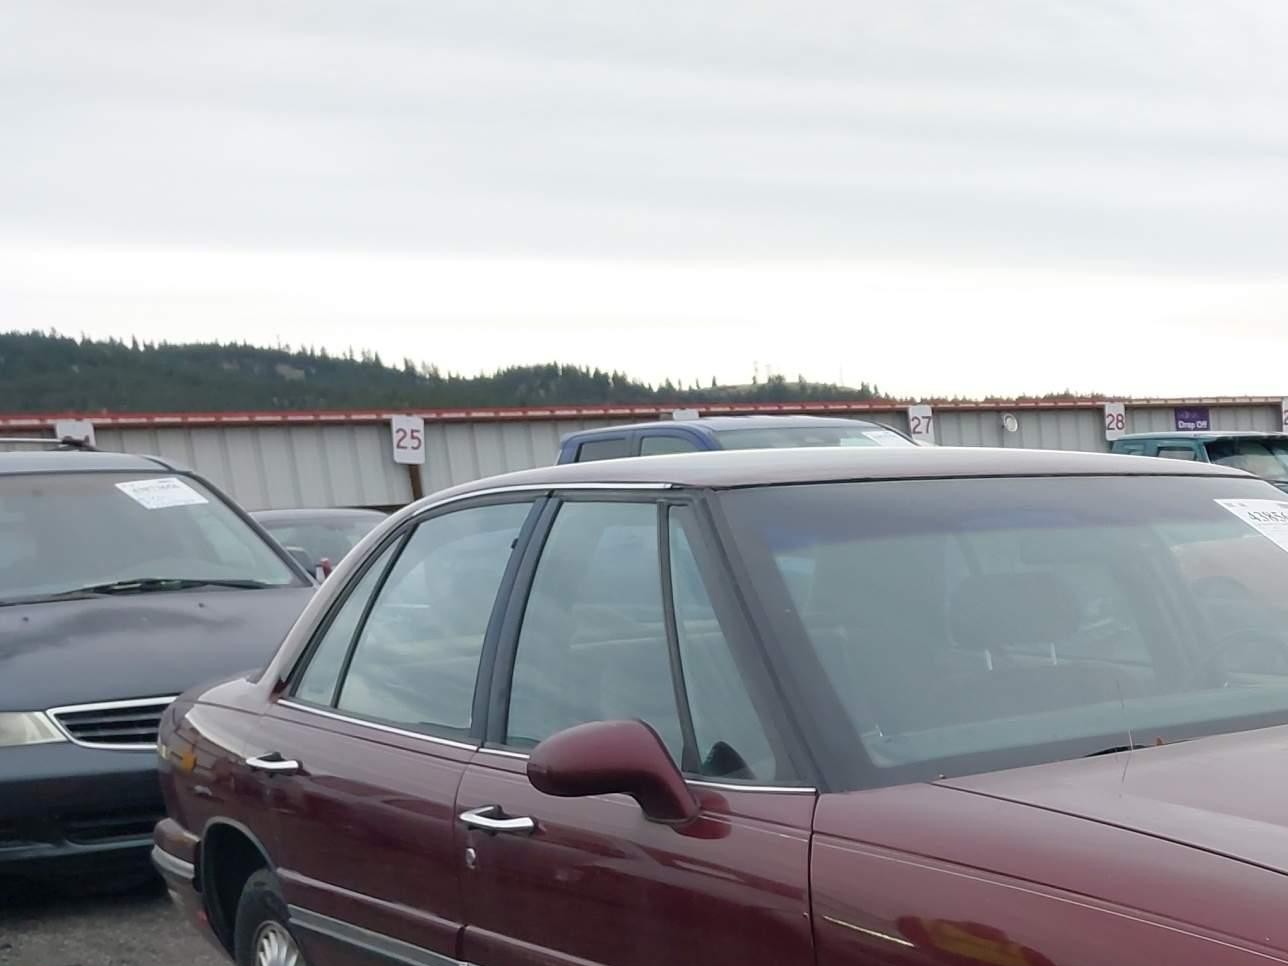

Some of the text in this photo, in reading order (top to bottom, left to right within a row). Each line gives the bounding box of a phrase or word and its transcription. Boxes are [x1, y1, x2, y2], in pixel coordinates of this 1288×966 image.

[910, 415, 933, 435] 27
[1106, 413, 1125, 431] 28
[1178, 420, 1208, 430] Drop Off
[395, 427, 422, 450] 25
